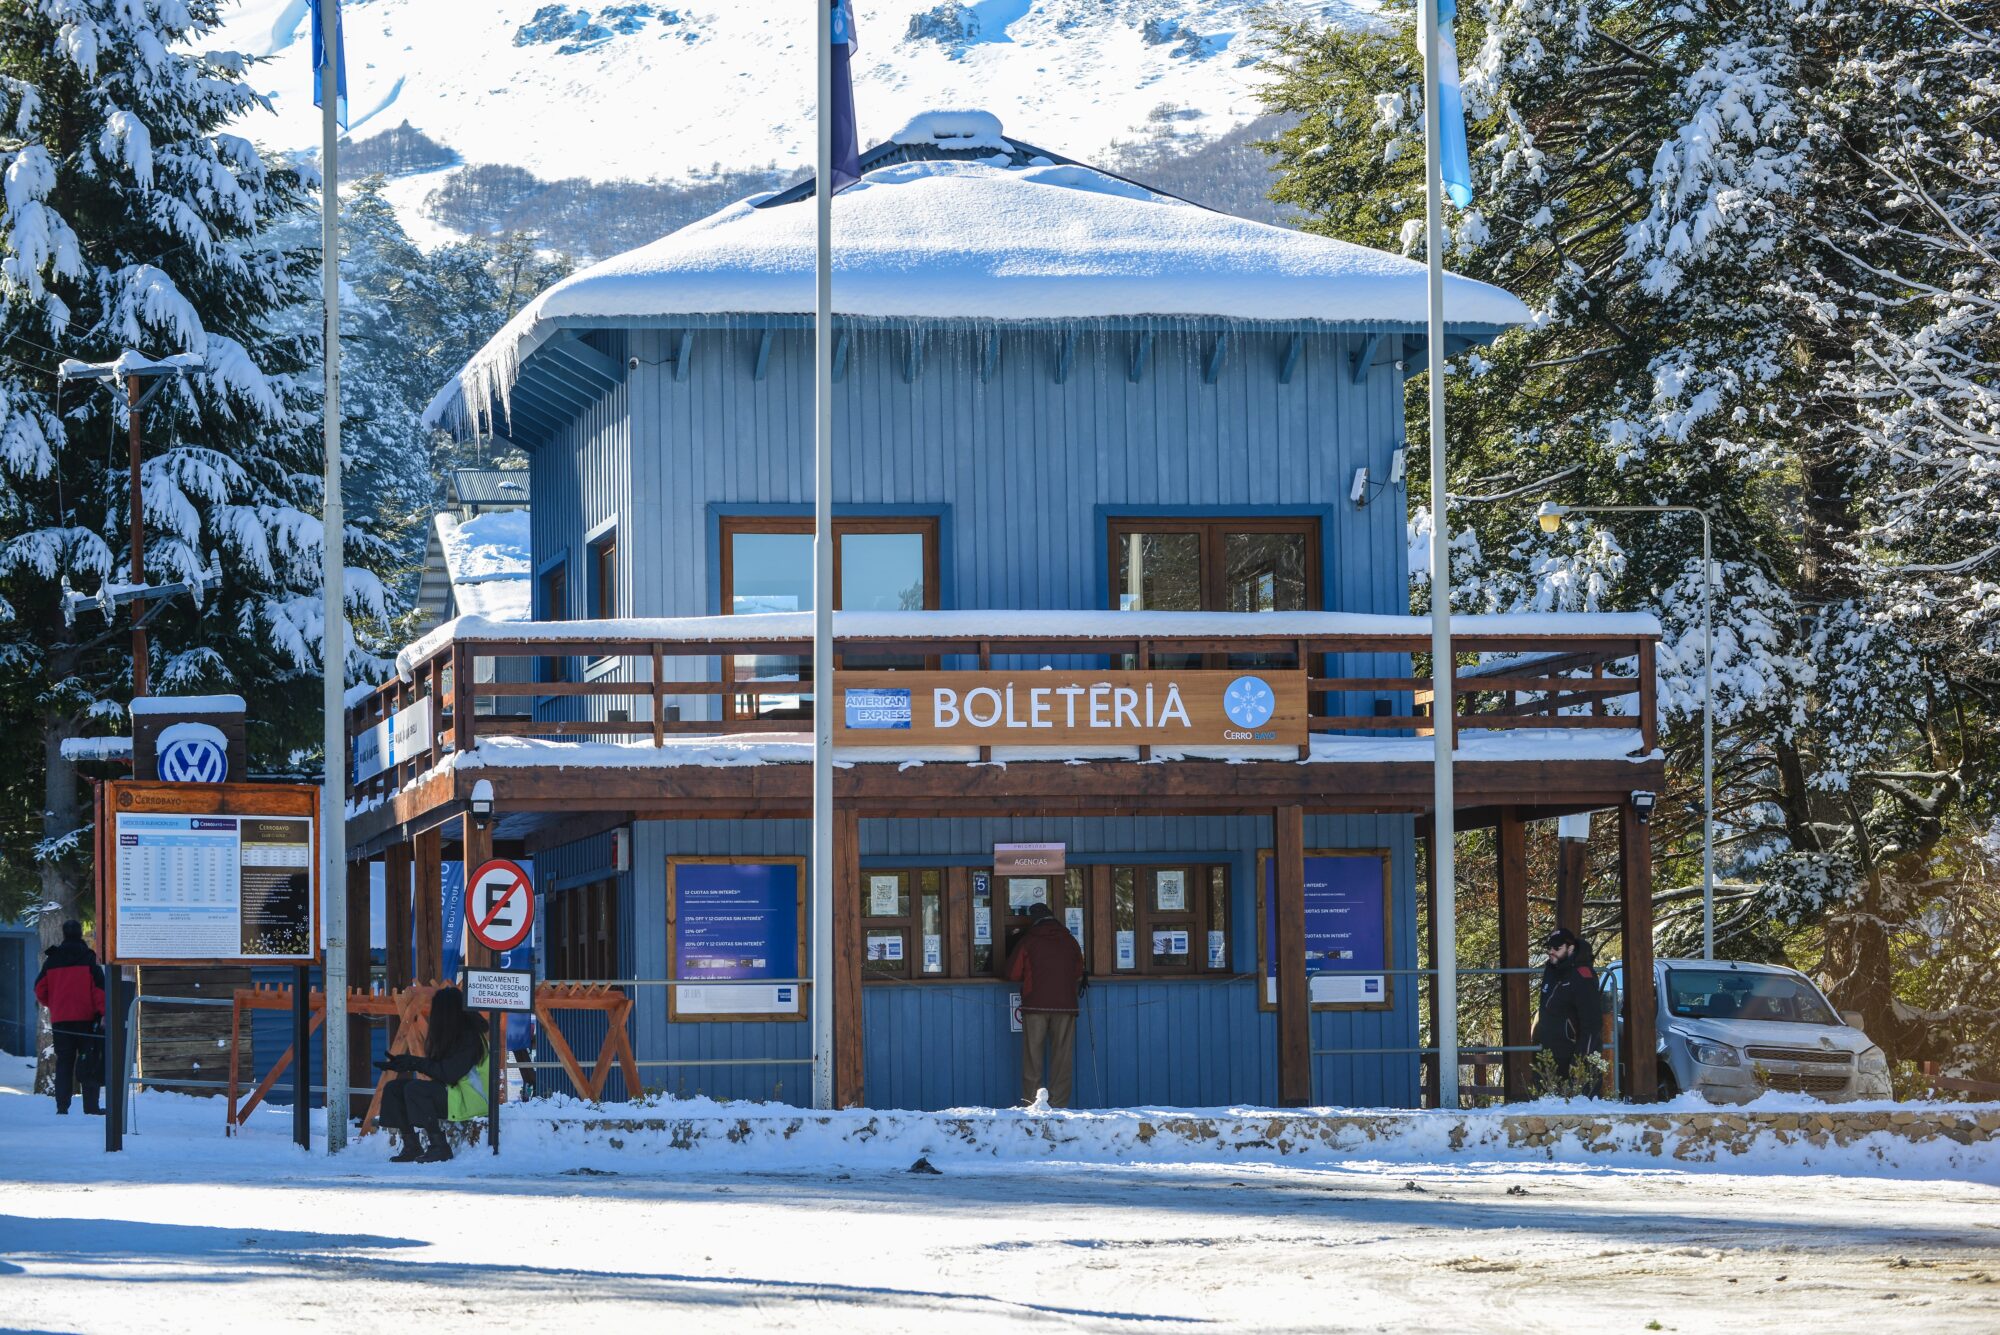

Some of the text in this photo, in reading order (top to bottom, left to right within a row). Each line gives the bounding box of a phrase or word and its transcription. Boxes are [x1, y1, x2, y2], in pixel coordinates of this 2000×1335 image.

[845, 696, 907, 708] AMERICAN
[858, 709, 911, 721] EXPRESS
[1014, 858, 1048, 866] AGENCIAS
[977, 877, 986, 891] 5
[448, 885, 460, 928] BOUTIQUE
[486, 883, 513, 926] E
[445, 930, 454, 943] SKI
[477, 975, 520, 984] UNICAMENTE
[499, 984, 530, 992] DESCENSO
[472, 997, 508, 1005] TOLERANCIA
